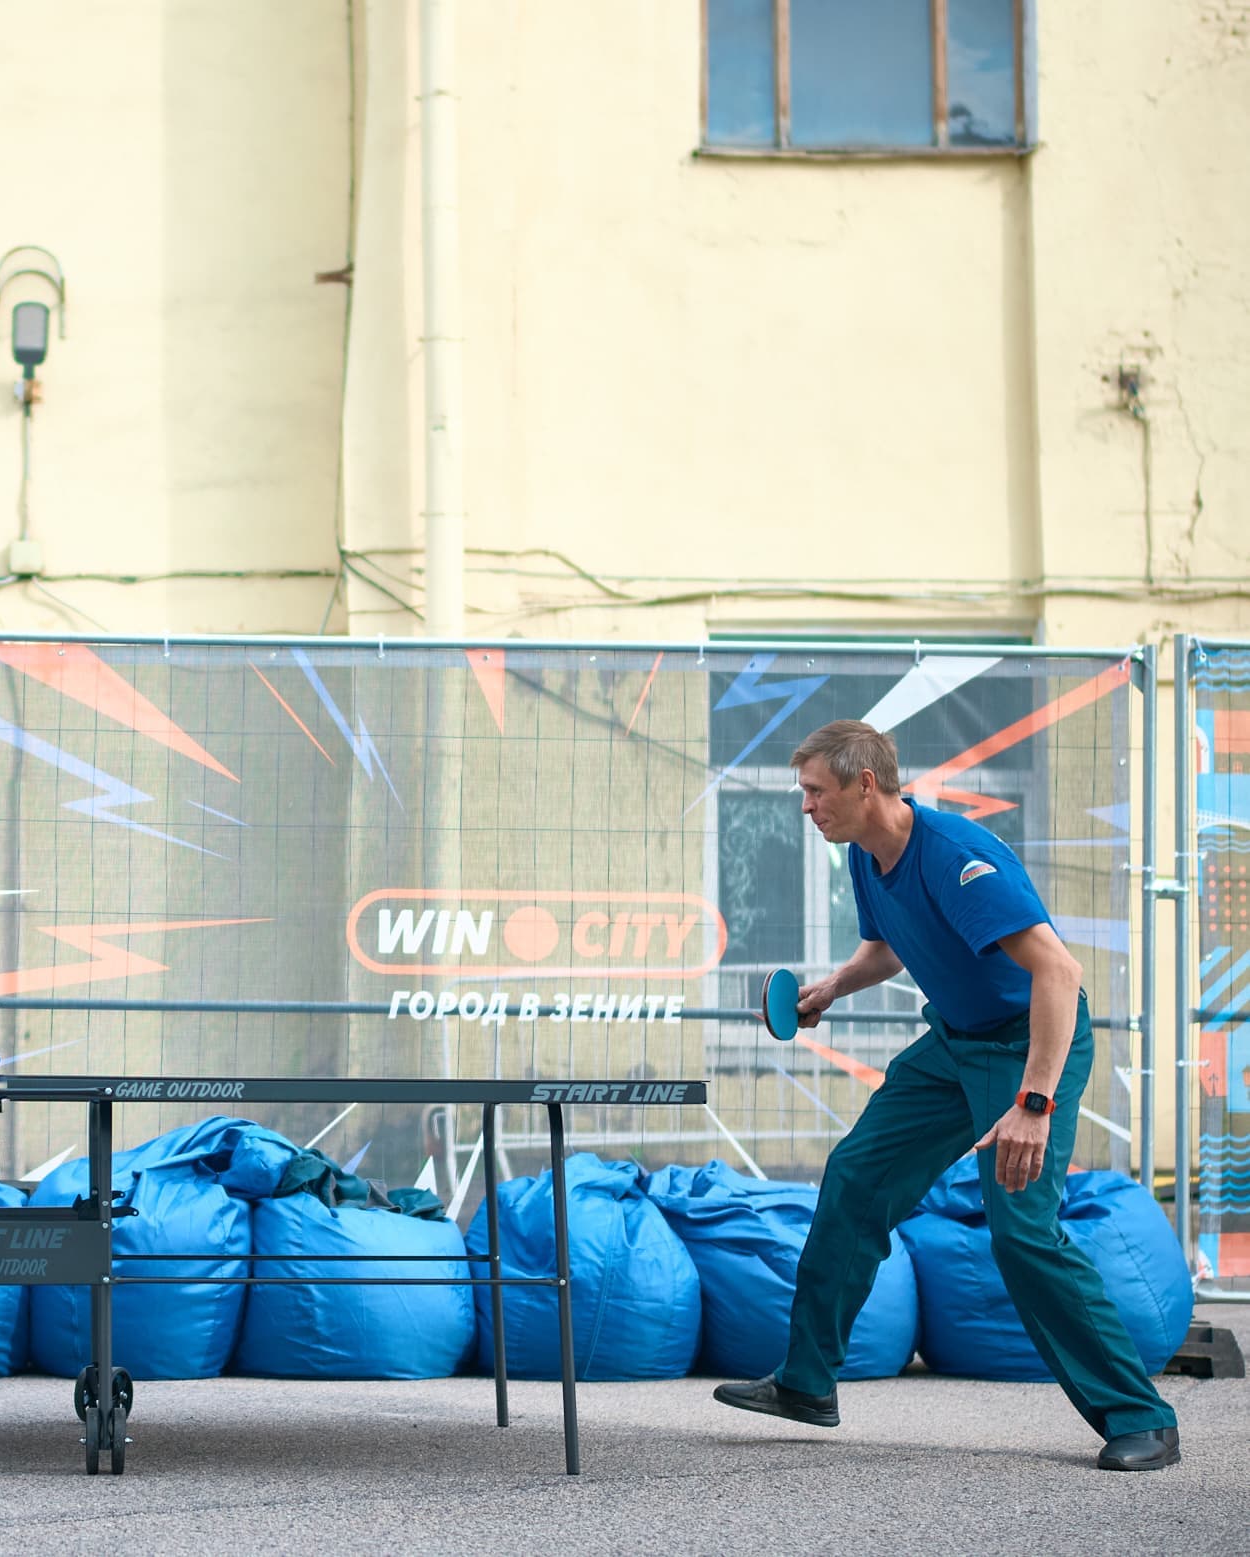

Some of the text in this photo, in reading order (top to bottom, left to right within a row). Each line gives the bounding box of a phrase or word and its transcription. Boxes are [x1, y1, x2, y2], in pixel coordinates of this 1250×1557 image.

[377, 909, 699, 958] WIN CITY
[388, 990, 685, 1026] ГОРОД В ЗЕНИТЕ
[116, 1082, 244, 1099] GAME OUTDOOR
[530, 1084, 688, 1102] START LINE
[10, 1228, 65, 1249] LINE
